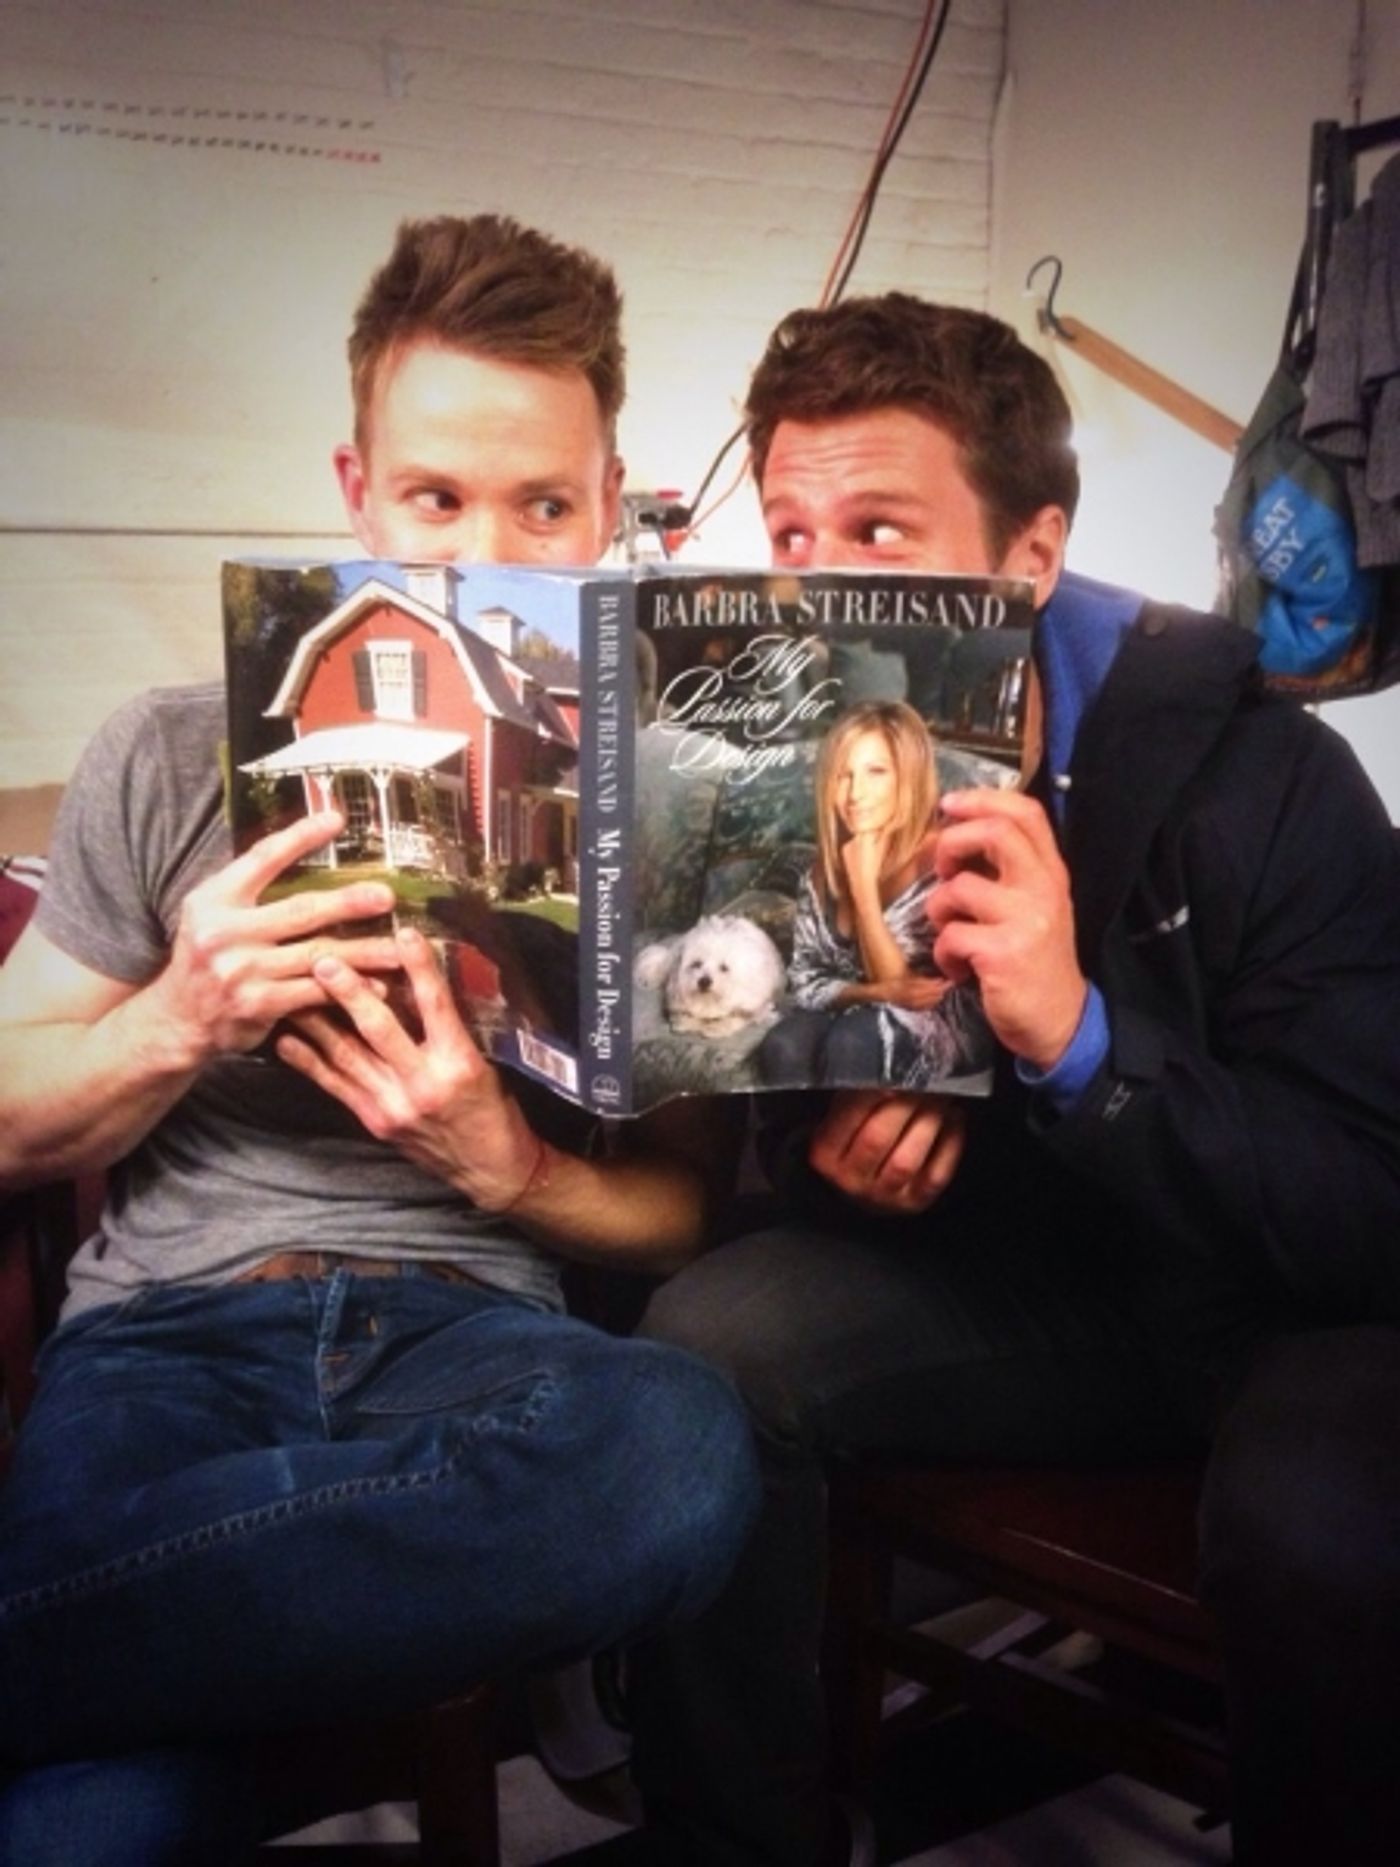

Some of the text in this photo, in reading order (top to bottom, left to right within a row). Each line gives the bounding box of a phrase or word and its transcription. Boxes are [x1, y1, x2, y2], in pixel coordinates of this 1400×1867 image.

[1249, 497, 1295, 552] EAT
[653, 589, 1007, 629] BARBRA STREISAND
[727, 633, 820, 695] My
[648, 665, 843, 742] Passion for
[669, 729, 797, 786] Design
[588, 595, 622, 1060] BARBRA STREISAND My Passion for Design
